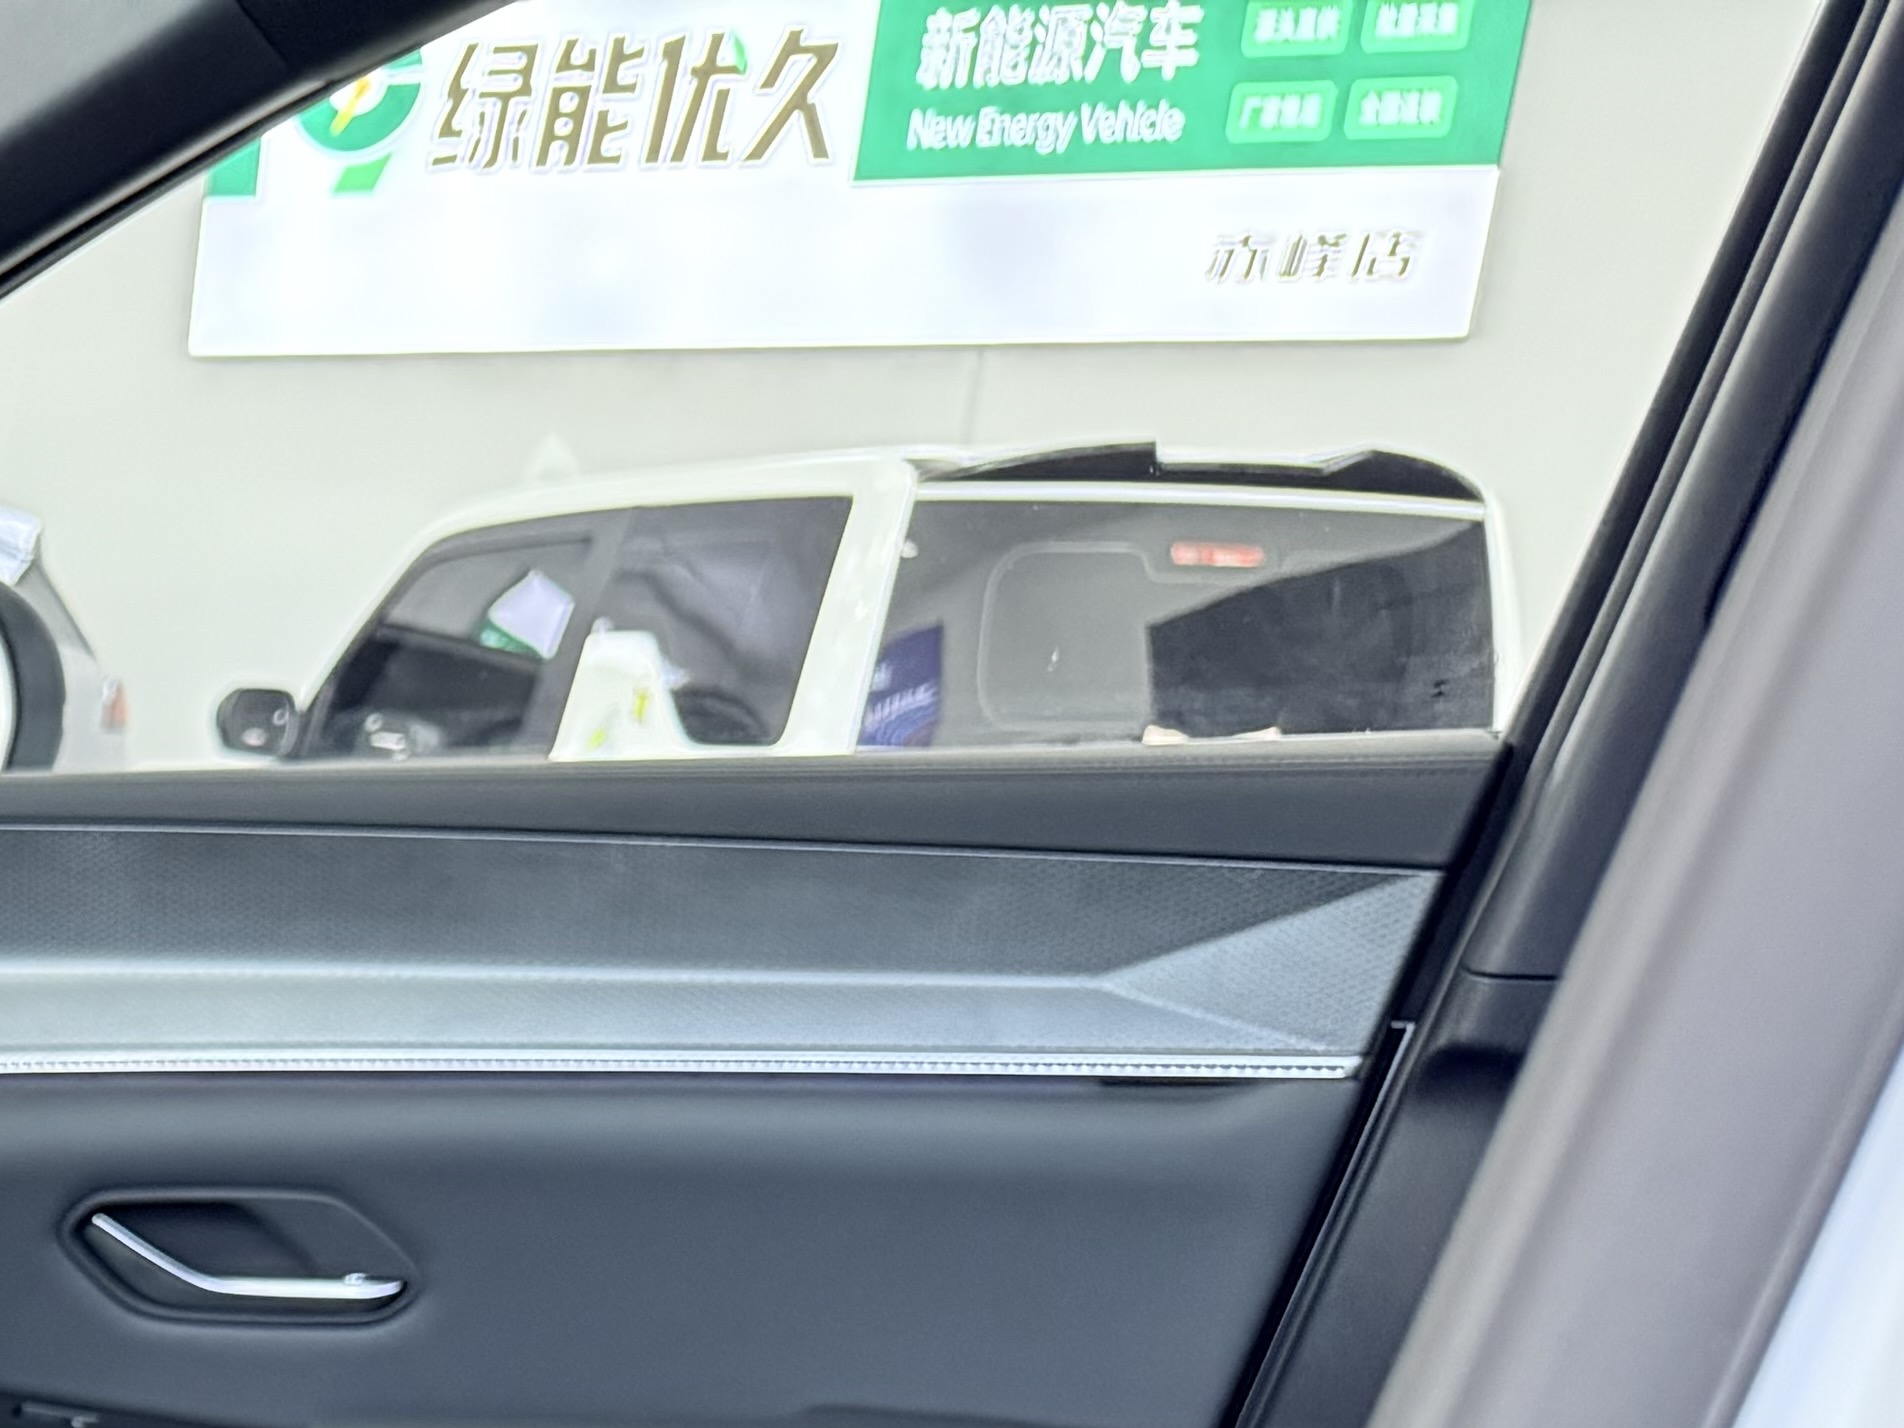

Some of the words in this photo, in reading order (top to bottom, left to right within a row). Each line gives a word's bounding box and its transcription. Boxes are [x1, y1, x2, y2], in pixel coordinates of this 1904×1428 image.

[916, 1, 1204, 90] 新能源汽车
[432, 28, 839, 170] 绿能优久
[906, 108, 975, 150] New
[976, 105, 1077, 155] Energy
[1080, 98, 1186, 145] Vehicle
